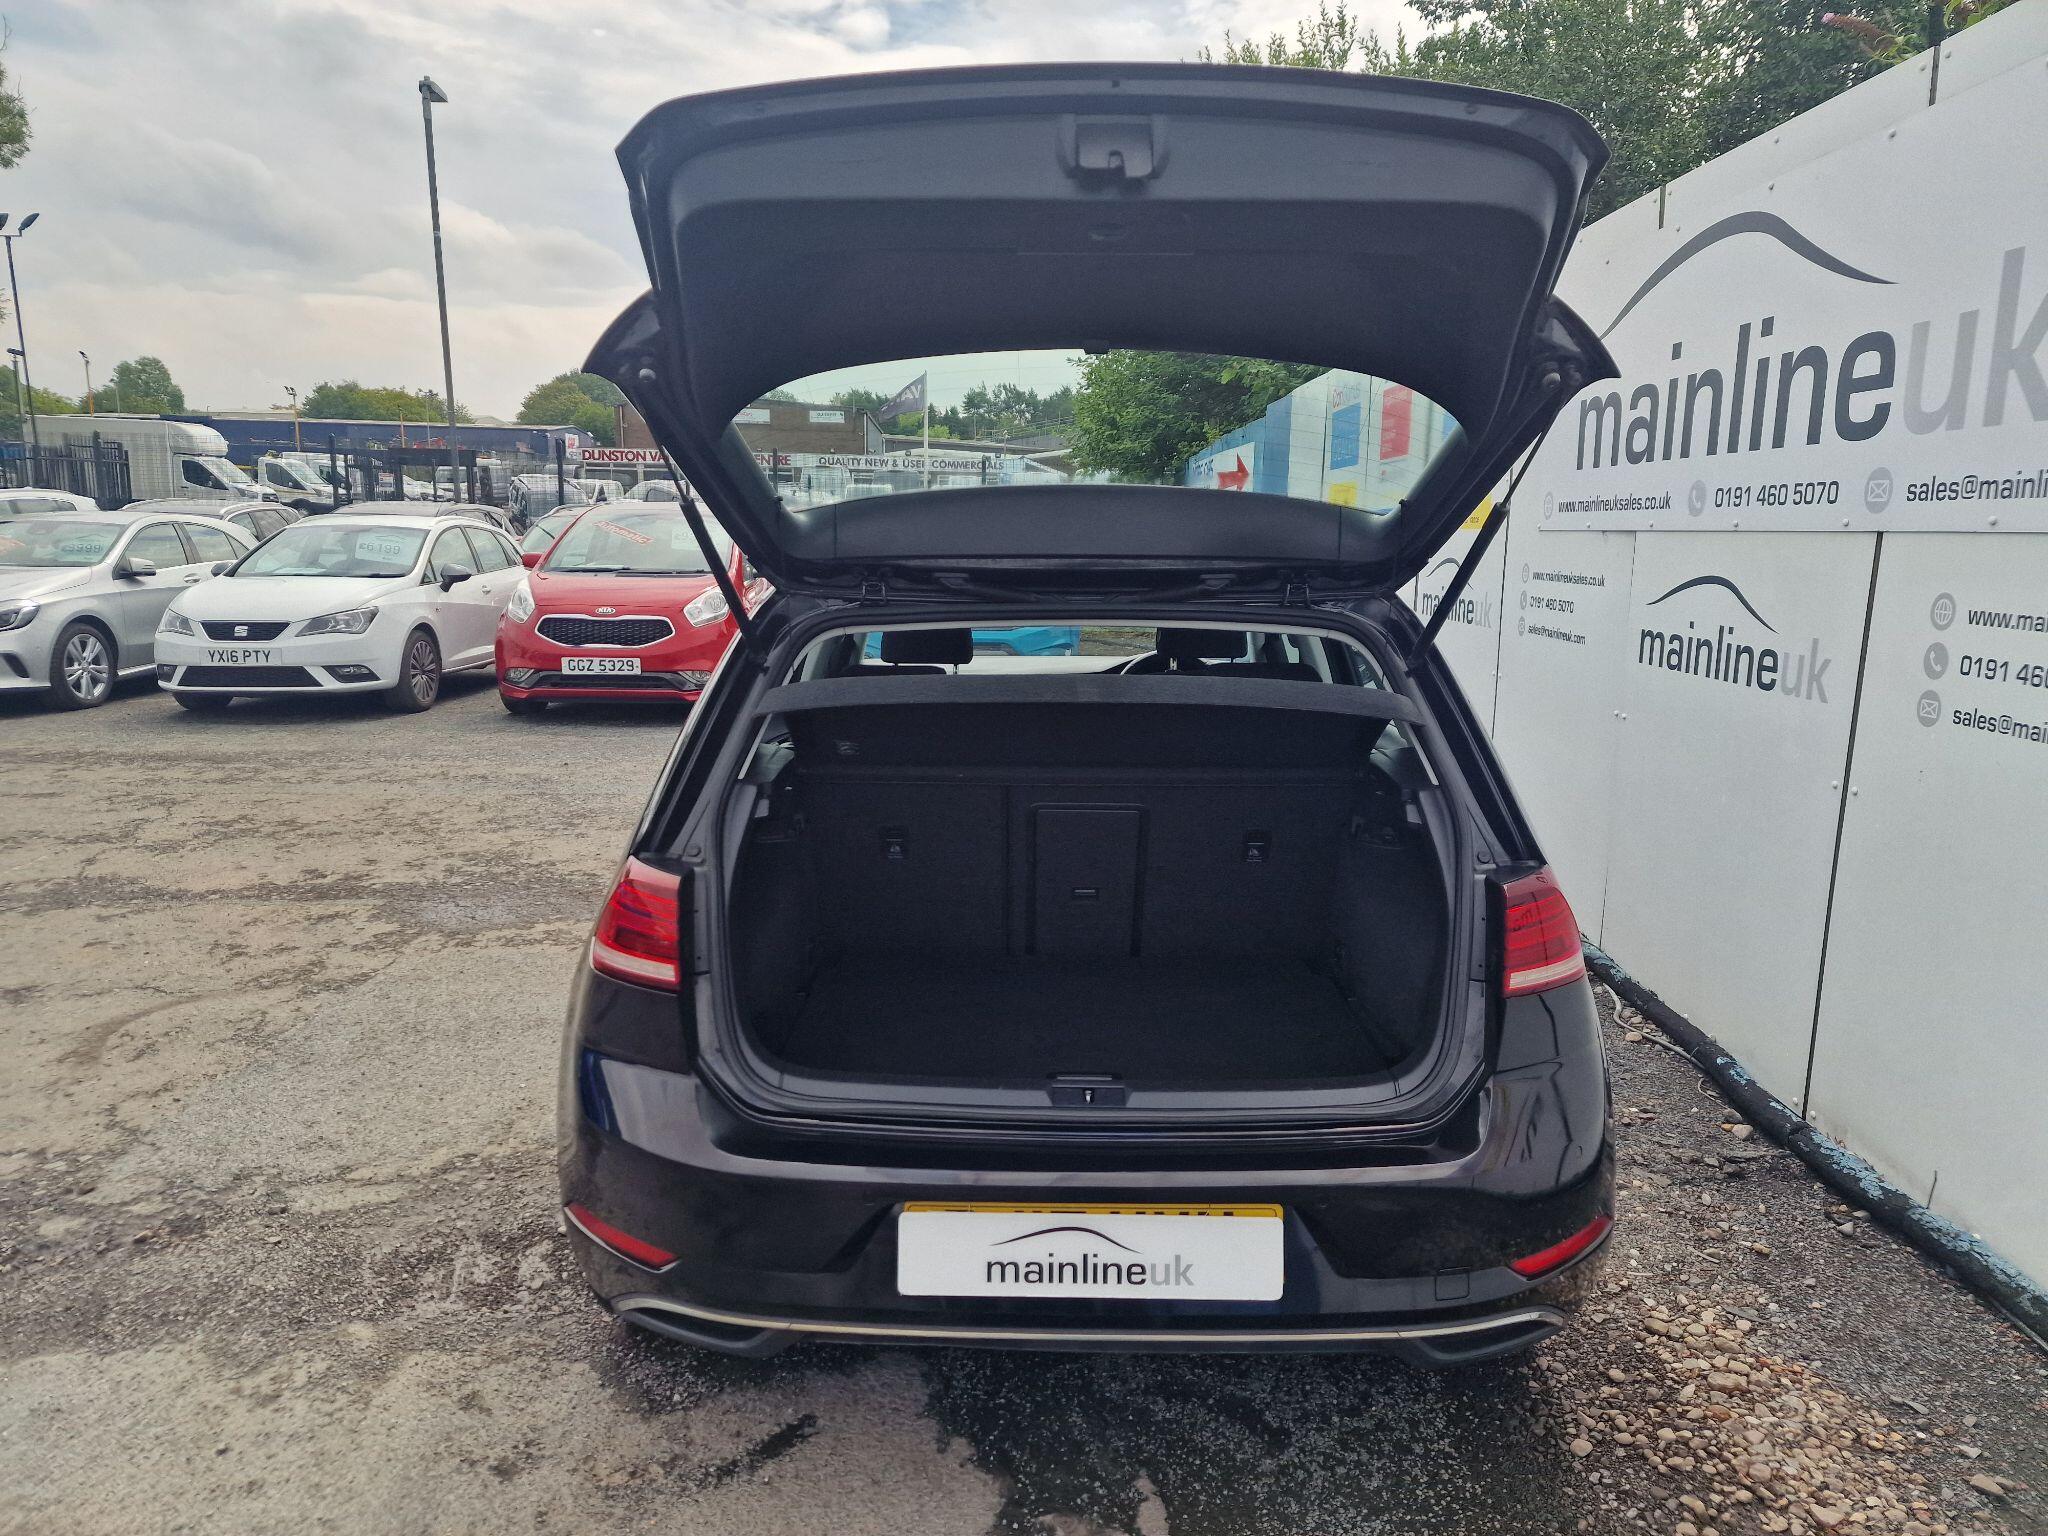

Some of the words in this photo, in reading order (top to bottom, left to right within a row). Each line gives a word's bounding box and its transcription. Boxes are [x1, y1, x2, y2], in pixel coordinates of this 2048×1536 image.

[1576, 246, 2048, 470] mainlineuk
[582, 450, 647, 462] DUNSTON
[649, 450, 669, 462] VA
[818, 457, 861, 467] QUALITY
[865, 458, 889, 467] NEW
[891, 459, 898, 467] &
[902, 460, 925, 469] USE
[931, 460, 1004, 470] COMMERCALS
[1558, 491, 1672, 513] www.mainlineuksales.co.uk
[1714, 485, 1752, 508] 0191
[1756, 483, 1789, 507] 460
[1792, 481, 1840, 506] 5070
[1530, 596, 1544, 609] 0191
[1558, 600, 1575, 613] 5070
[207, 649, 239, 663] YX16
[242, 649, 271, 663] PTY
[568, 659, 595, 672] GGZ
[598, 659, 635, 672] 5329
[1638, 620, 1832, 704] mainlineuk
[1959, 655, 2009, 682] 0191
[1952, 707, 2048, 745] sales@mai
[986, 1252, 1195, 1287] mainlineuk
